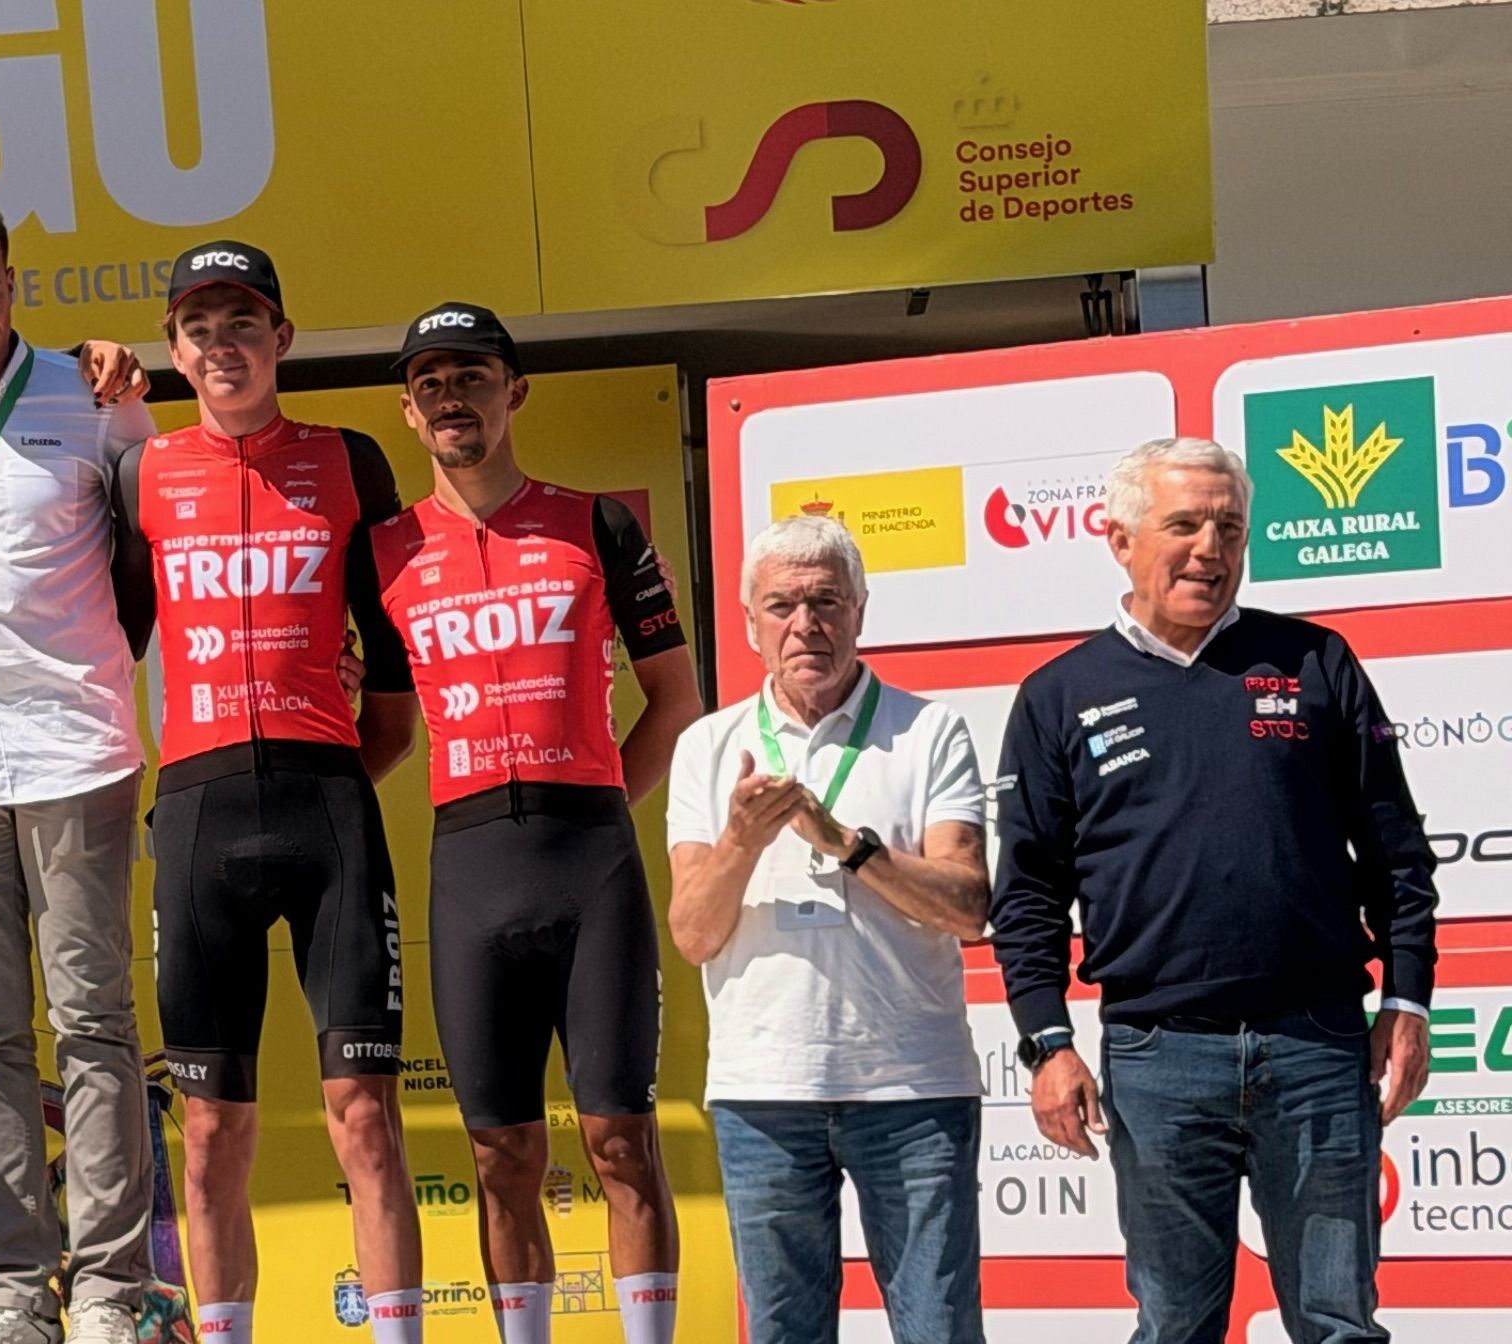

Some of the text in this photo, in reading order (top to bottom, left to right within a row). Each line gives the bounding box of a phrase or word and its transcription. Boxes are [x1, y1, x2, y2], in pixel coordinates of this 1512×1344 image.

[956, 135, 1072, 165] Consejo
[959, 164, 1081, 197] Superior
[959, 190, 1134, 226] de Deportes
[55, 264, 173, 304] CICLIS
[1028, 488, 1072, 504] ZONA
[862, 506, 922, 521] MINISTERIO
[862, 518, 936, 535] DE HACIENDA
[1266, 512, 1420, 540] CAIXA RURAL
[1297, 541, 1390, 565] GALEGA
[163, 546, 329, 602] FROIZ
[408, 596, 575, 665] FROIZ
[1411, 1131, 1512, 1187] inb
